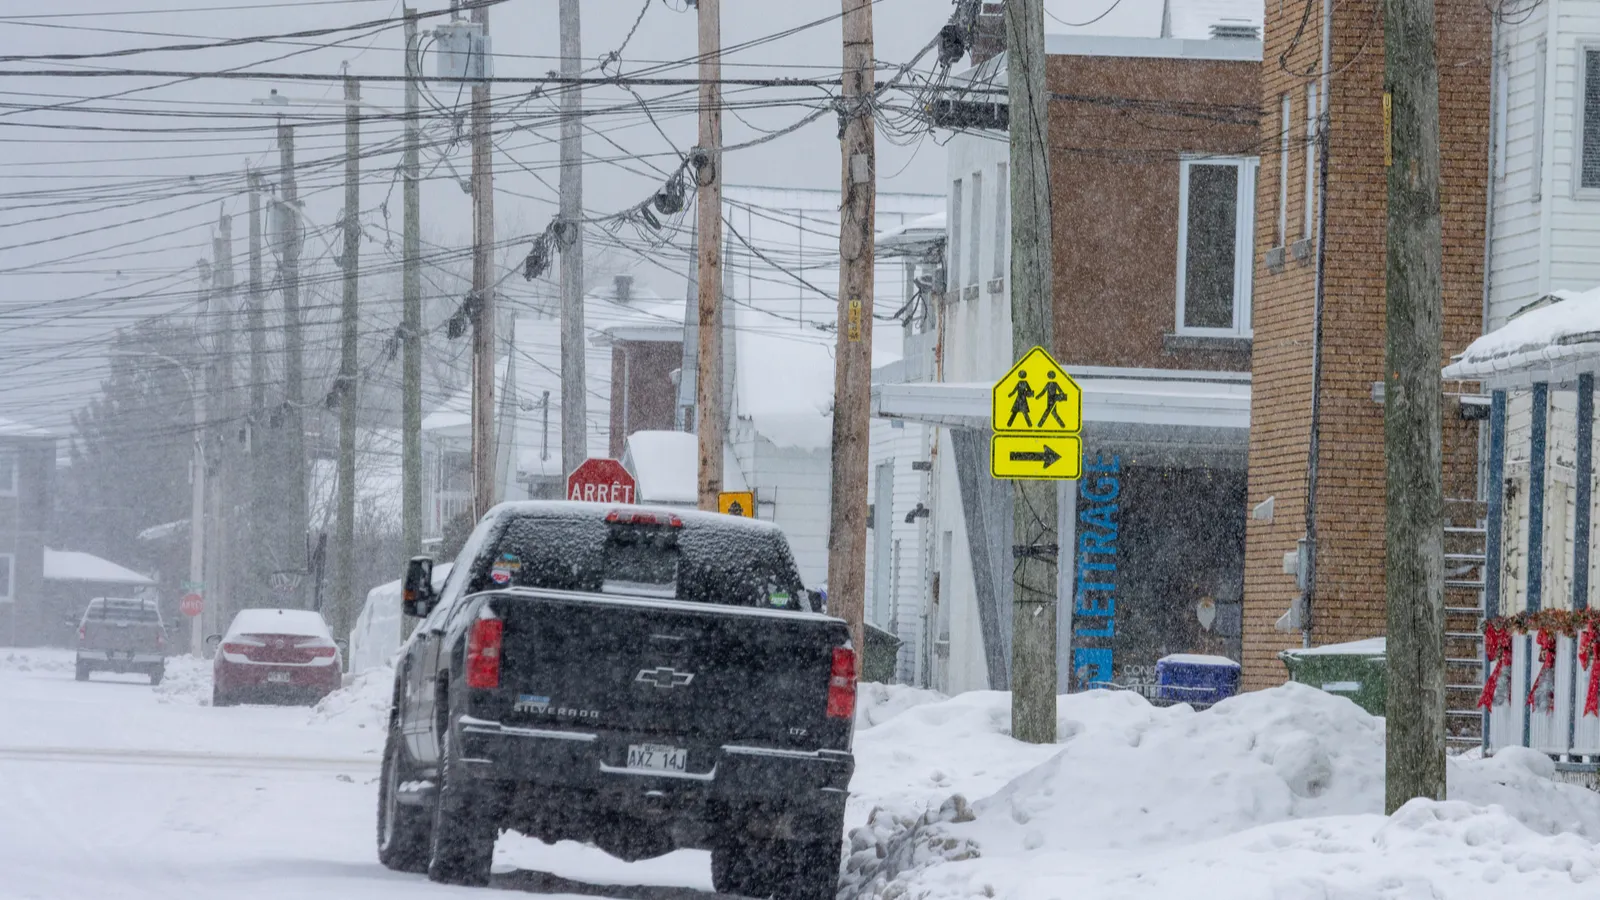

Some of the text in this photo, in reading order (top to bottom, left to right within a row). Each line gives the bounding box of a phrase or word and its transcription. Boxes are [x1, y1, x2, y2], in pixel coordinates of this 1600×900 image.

[570, 480, 632, 504] ARRÊT
[1075, 454, 1120, 638] LETTRAGE
[513, 702, 600, 718] SILVERADO
[789, 727, 806, 736] LTZ
[629, 750, 685, 770] AXZ 14J
